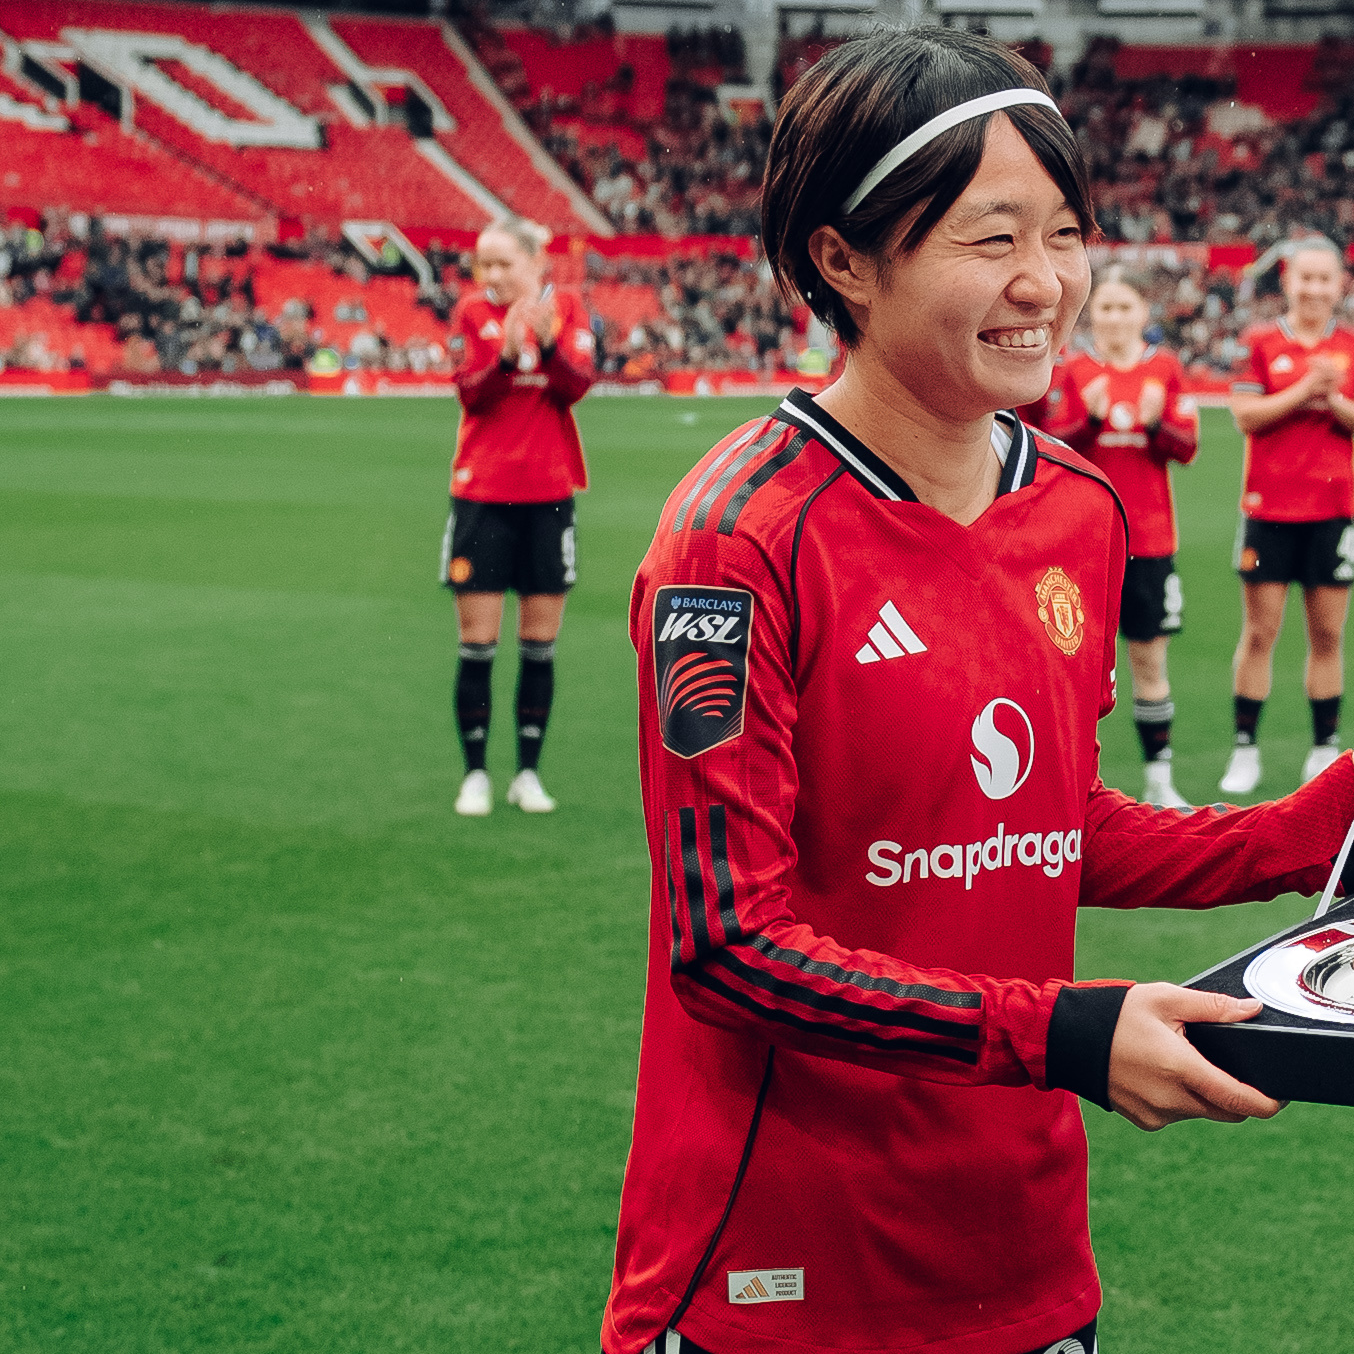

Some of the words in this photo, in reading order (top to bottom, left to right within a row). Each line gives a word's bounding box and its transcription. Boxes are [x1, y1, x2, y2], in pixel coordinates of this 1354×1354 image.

[1040, 573, 1078, 602] MANCHESTER
[682, 597, 742, 612] BARCLAYS
[658, 612, 742, 644] WSL
[1054, 634, 1079, 649] UNITED
